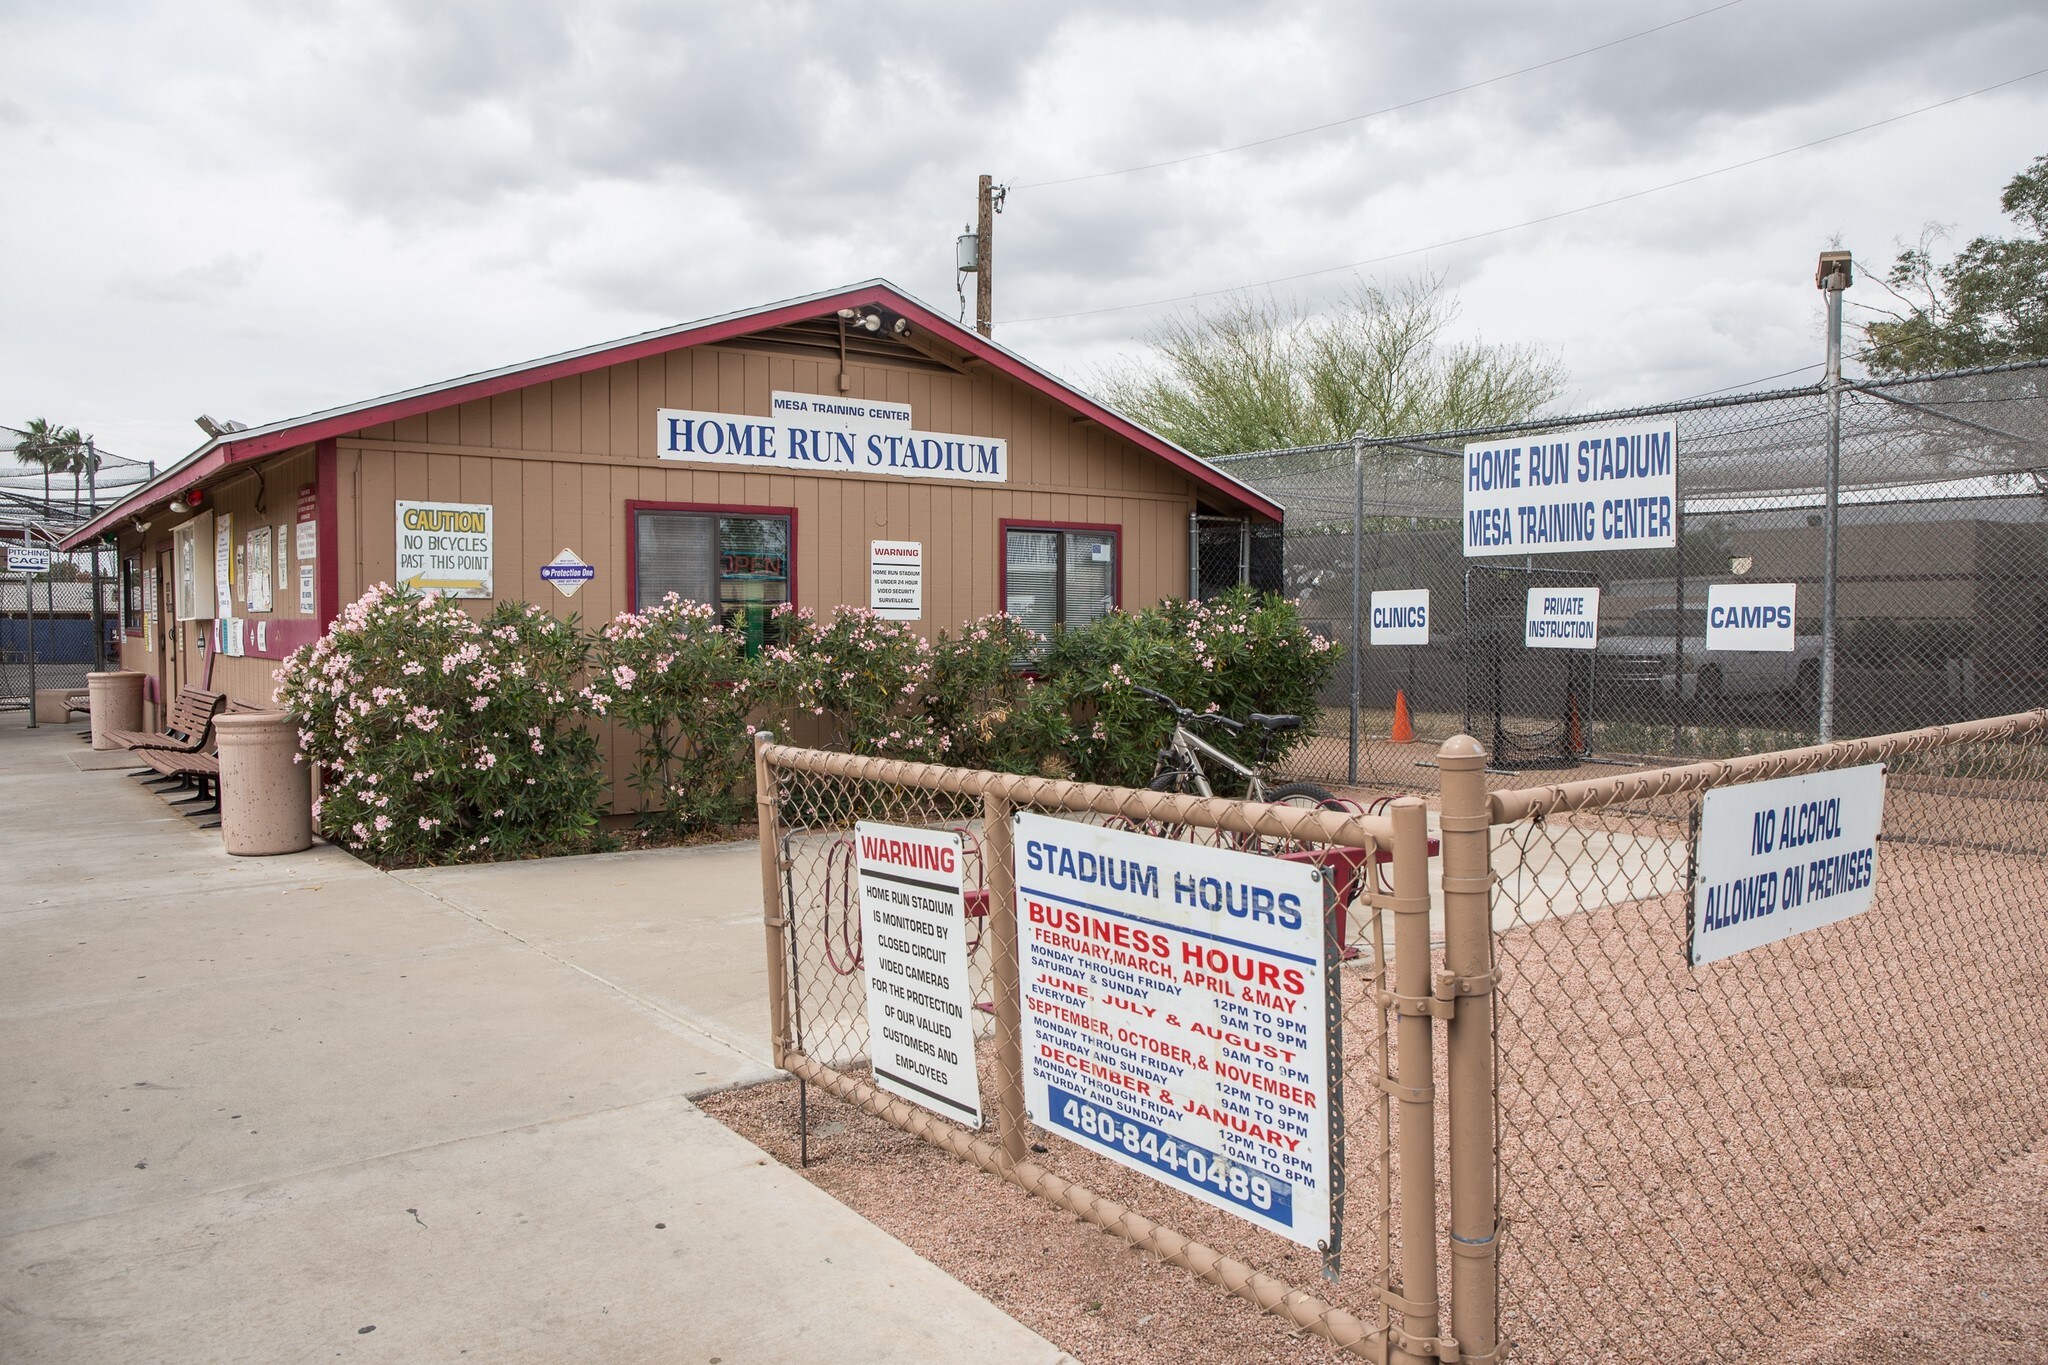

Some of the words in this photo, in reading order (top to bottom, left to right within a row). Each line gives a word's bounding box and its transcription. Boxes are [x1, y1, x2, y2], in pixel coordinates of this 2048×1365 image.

[774, 398, 808, 412] MESA
[812, 402, 865, 418] TRAINING
[869, 407, 910, 422] CENTER
[667, 417, 776, 459] HOME
[787, 427, 857, 465] RUN
[867, 434, 1000, 475] STADIUM
[1468, 447, 1521, 492] HOME
[1528, 443, 1570, 487] RUN
[1577, 431, 1671, 483] STADIUM
[403, 508, 486, 534] CAUTION
[1468, 507, 1512, 547] MESA
[1518, 501, 1595, 544] TRAINING
[1602, 495, 1671, 541] CENTER
[8, 549, 49, 557] PITCHING
[401, 554, 424, 568] PAST
[430, 554, 455, 570] THIS
[457, 556, 489, 570] POINT
[404, 535, 423, 550] NO
[428, 536, 488, 552] BICYCLES
[874, 548, 919, 557] WARNING
[550, 568, 581, 577] Protection
[582, 568, 593, 577] One
[1373, 606, 1426, 629] CLINICS
[1543, 596, 1584, 616] PRIVATE
[1710, 605, 1792, 630] CAMPS
[1528, 619, 1595, 639] INSTRUCTION
[1751, 809, 1776, 856] NO
[1779, 797, 1842, 850] ALCOHOL
[861, 835, 955, 874] WARNING
[866, 885, 890, 902] HOME
[891, 891, 910, 907] RUN
[912, 895, 954, 917] STADIUM
[1026, 840, 1159, 899] STADIUM
[1173, 871, 1302, 931] HOURS
[1703, 871, 1778, 934] ALLOWED
[1782, 864, 1805, 910] ON
[1807, 847, 1873, 904] PREMISES
[873, 909, 881, 923] IS
[882, 912, 935, 937] MONITORED
[936, 925, 949, 940] BY
[878, 934, 910, 954] CLOSED
[912, 943, 947, 964] CIRCUIT
[1029, 901, 1170, 959] BUSINESS
[1182, 941, 1305, 995] HOURS
[879, 957, 904, 976] VIDEO
[905, 965, 950, 990] CAMERAS
[1031, 943, 1074, 964] MONDAY
[1077, 957, 1134, 983] THROUGH
[1138, 976, 1182, 996] FRIDAY
[1213, 998, 1248, 1017] 12PM
[1253, 1009, 1271, 1024] TO
[1276, 1017, 1307, 1035] 9PM
[1183, 970, 1235, 998] APRIL
[872, 977, 888, 993] FOR
[889, 983, 905, 999] THE
[907, 989, 963, 1019] PROTECTION
[1031, 956, 1086, 980] SATURDAY
[1090, 974, 1098, 984] &
[1101, 978, 1149, 1000] SUNDAY
[1220, 1014, 1249, 1032] 9AM
[1254, 1024, 1272, 1038] TO
[1277, 1032, 1307, 1050] 9PM
[884, 1004, 895, 1018] OF
[896, 1009, 915, 1026] OUR
[916, 1016, 952, 1039] VALUED
[1032, 983, 1086, 1009] EVERYDAY
[1222, 1047, 1251, 1064] 9AM
[1256, 1057, 1273, 1072] TO
[1279, 1065, 1309, 1084] 9PM
[1036, 973, 1094, 1001] JUNE,
[1102, 994, 1157, 1018] JULY
[1166, 1013, 1182, 1028] &
[1190, 1022, 1297, 1063] AUGUST
[883, 1026, 936, 1057] CUSTOMERS
[937, 1047, 958, 1065] AND
[1028, 996, 1113, 1041] SEPTEMBER,
[1215, 1060, 1317, 1109] NOVEMBER
[895, 1053, 948, 1085] EMPLOYEES
[1033, 1016, 1077, 1039] MONDAY
[1081, 1032, 1137, 1060] THROUGH
[1141, 1054, 1184, 1077] FRIDAY
[1215, 1082, 1251, 1102] 12PM
[1256, 1095, 1274, 1110] TO
[1279, 1104, 1309, 1123] 9PM
[1035, 1029, 1090, 1056] SATURDAY
[1094, 1051, 1116, 1066] AND
[1120, 1061, 1168, 1085] SUNDAY
[1221, 1098, 1250, 1117] 9AM
[1254, 1110, 1273, 1125] TO
[1278, 1119, 1308, 1138] 9PM
[1034, 1056, 1077, 1079] MONDAY
[1081, 1074, 1136, 1103] THROUGH
[1141, 1098, 1184, 1122] FRIDAY
[1218, 1129, 1254, 1150] 12PM
[1259, 1143, 1277, 1158] TO
[1282, 1153, 1312, 1173] 8PM
[1041, 1043, 1150, 1097] DECEMBER
[1159, 1089, 1174, 1105] &
[1183, 1100, 1301, 1152] JANUARY
[1033, 1067, 1087, 1095] SATURDAY
[1090, 1090, 1112, 1106] AND
[1116, 1101, 1163, 1127] SUNDAY
[1221, 1143, 1257, 1165] 10AM
[1262, 1158, 1280, 1174] TO
[1285, 1168, 1316, 1189] 8PM
[1062, 1098, 1272, 1211] 480-844-0489
